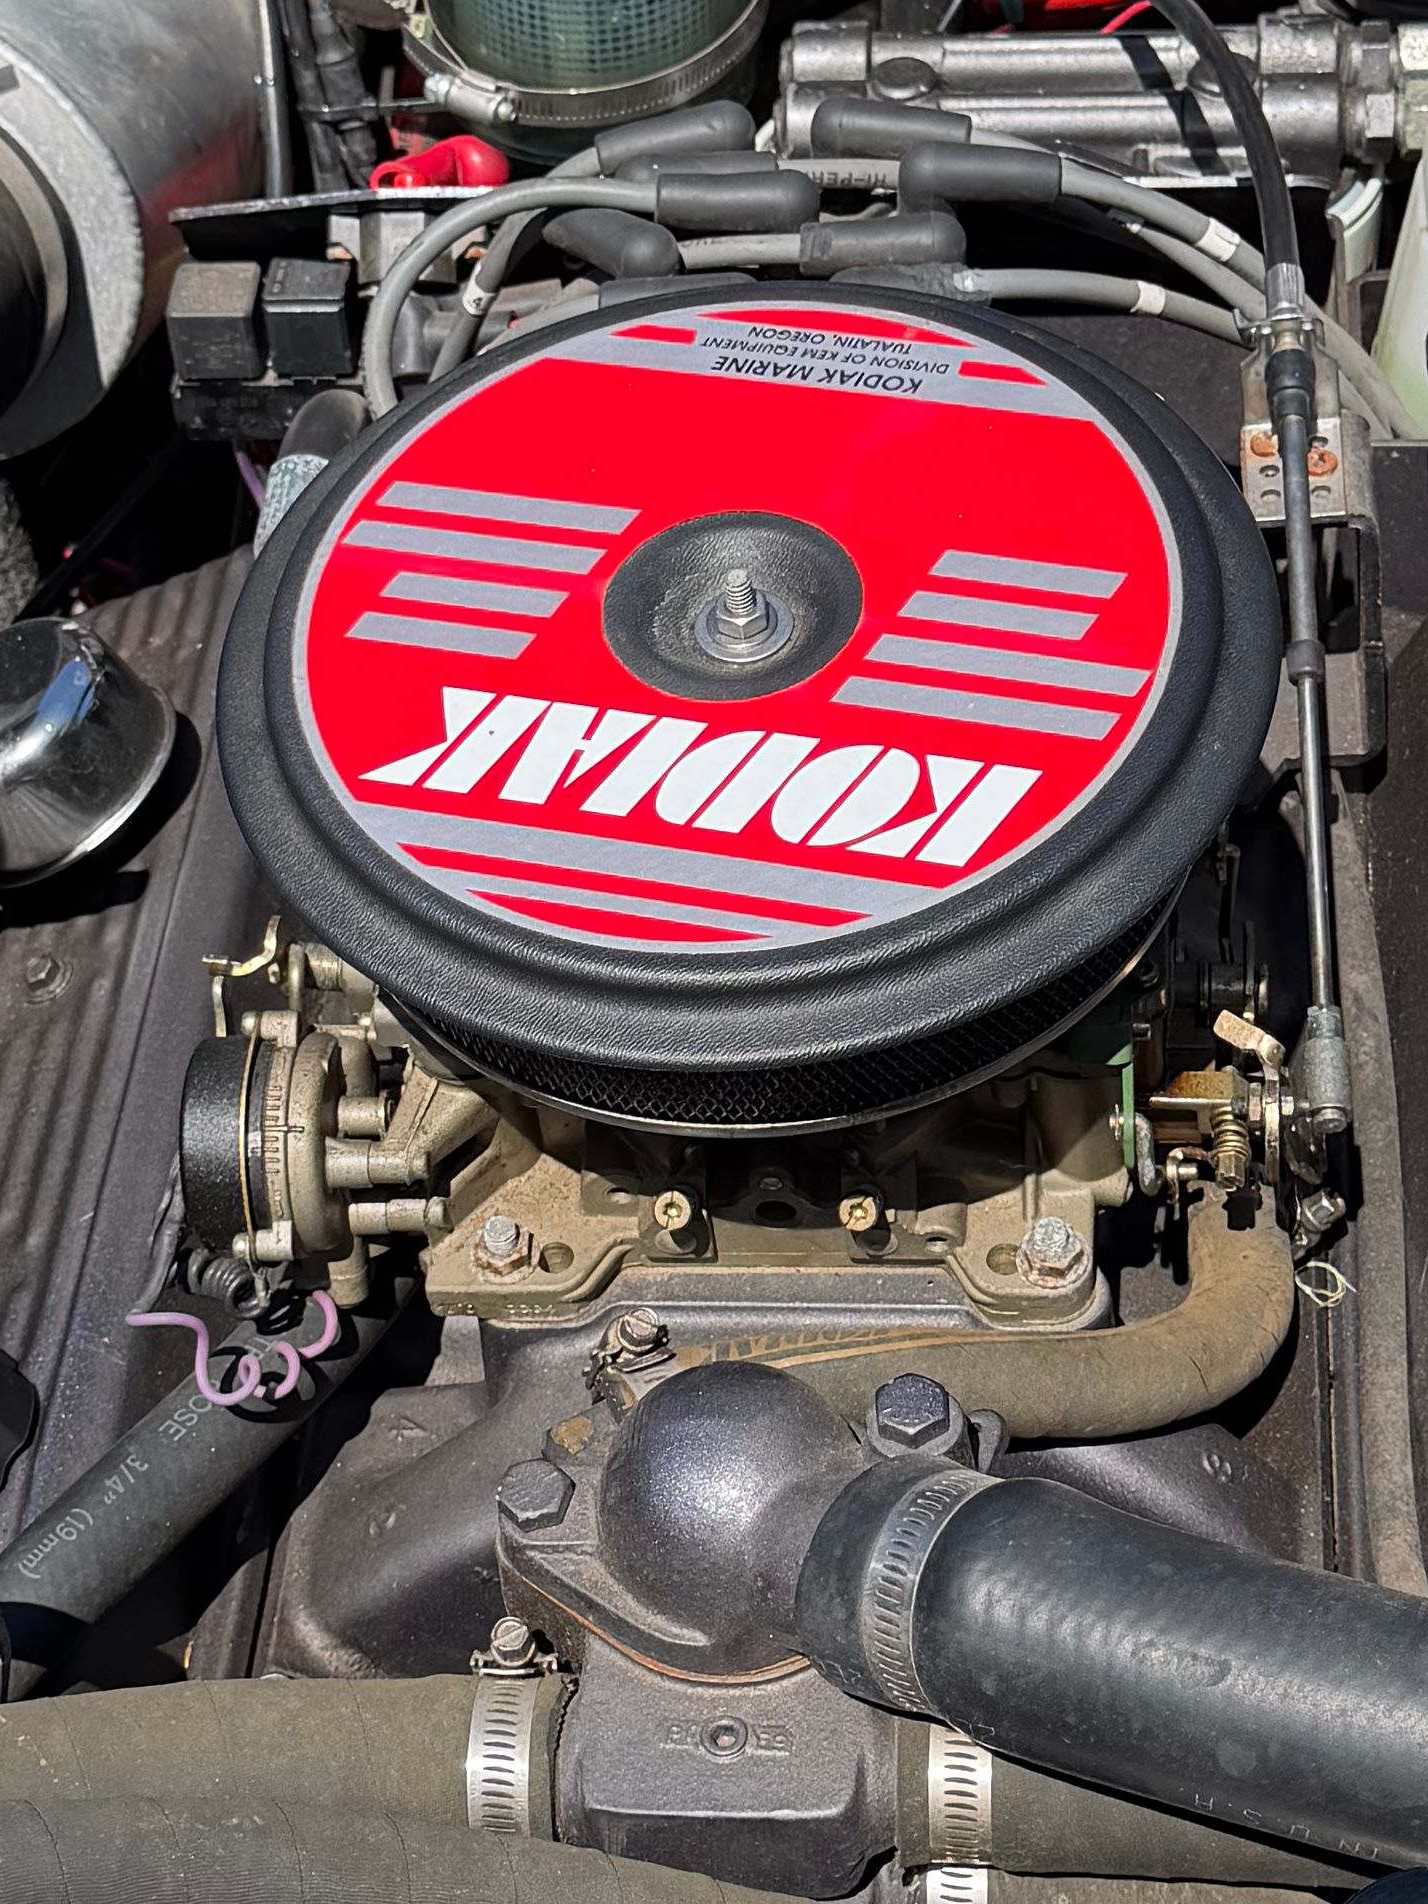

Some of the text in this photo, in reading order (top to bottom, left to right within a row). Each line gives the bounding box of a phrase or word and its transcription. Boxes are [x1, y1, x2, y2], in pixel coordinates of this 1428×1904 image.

[700, 336, 950, 375] DIVISION OF KEM EQUIPMENT
[747, 325, 913, 354] TUALATIN, OREGON
[710, 355, 923, 395] KODIAK MARINE
[359, 685, 1043, 867] KODIAK
[158, 1378, 221, 1443] OSE
[18, 1508, 95, 1581] (19mm)
